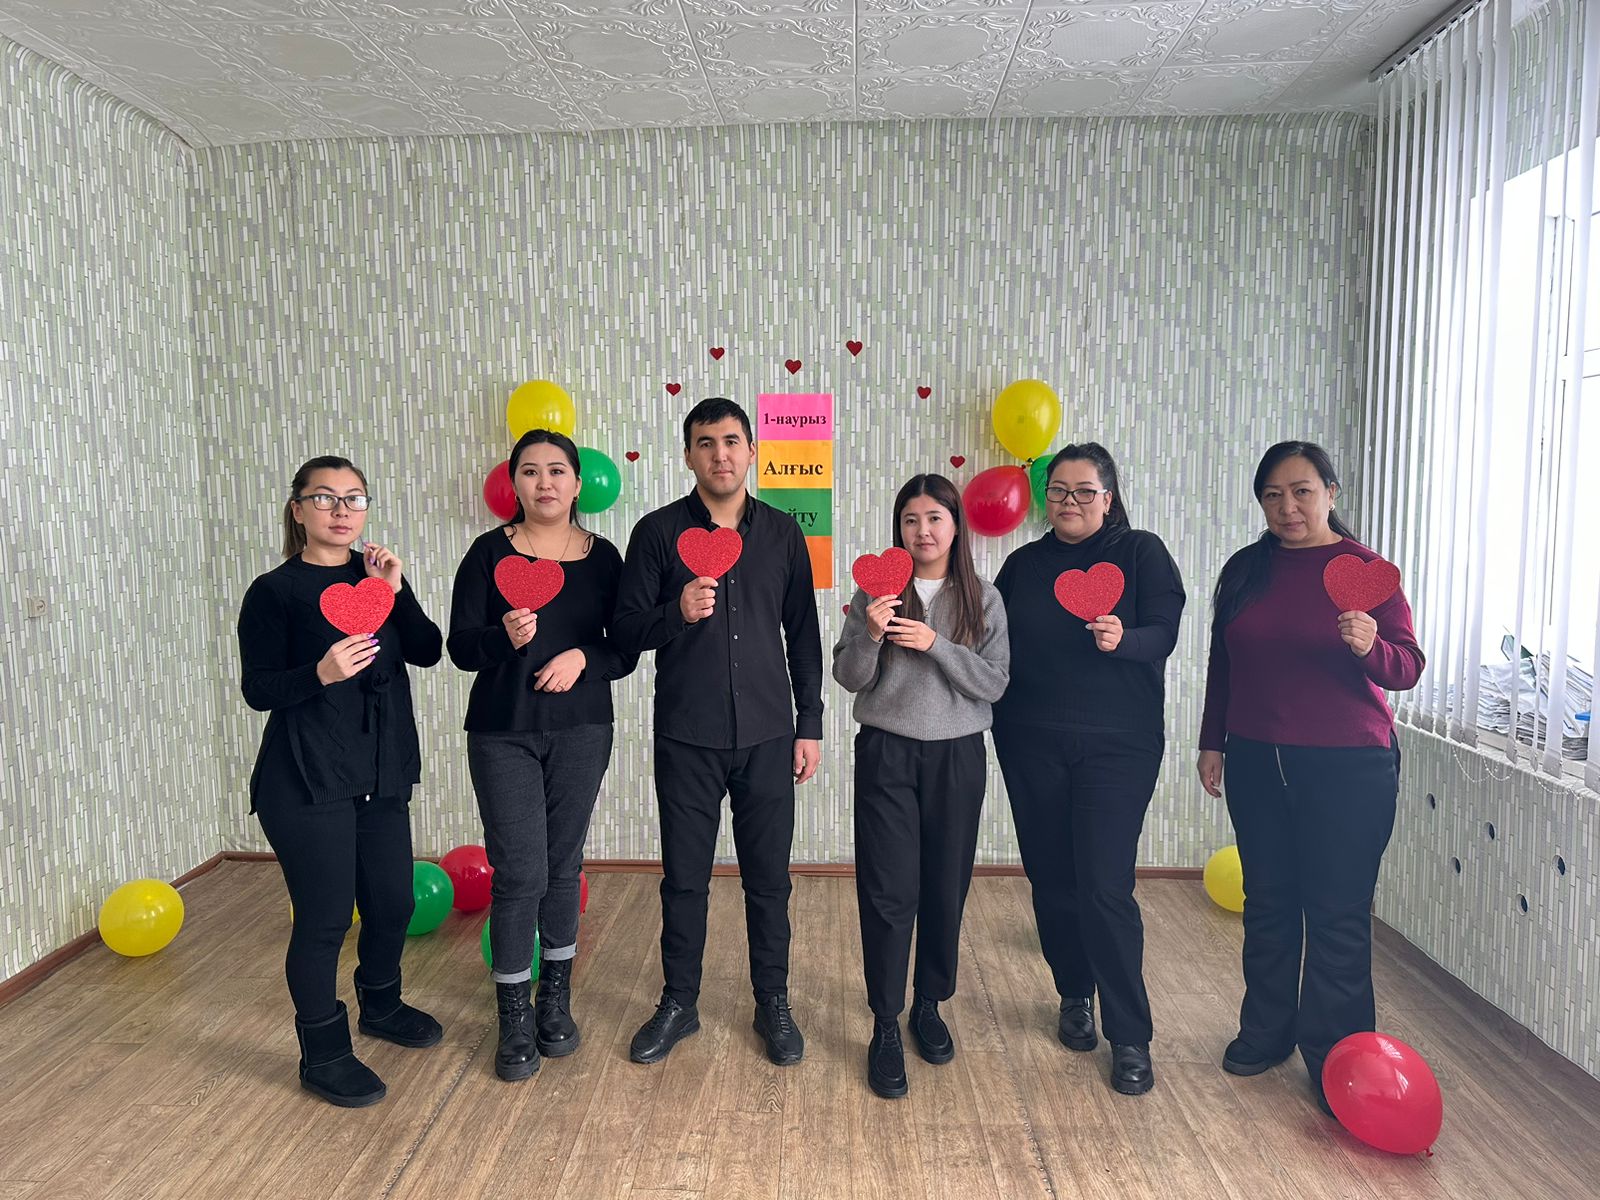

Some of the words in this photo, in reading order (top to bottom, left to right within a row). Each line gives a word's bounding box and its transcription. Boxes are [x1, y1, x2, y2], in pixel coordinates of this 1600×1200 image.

[764, 412, 827, 428] 1-наурыз
[763, 460, 824, 475] Алғыс
[787, 507, 818, 527] йту
